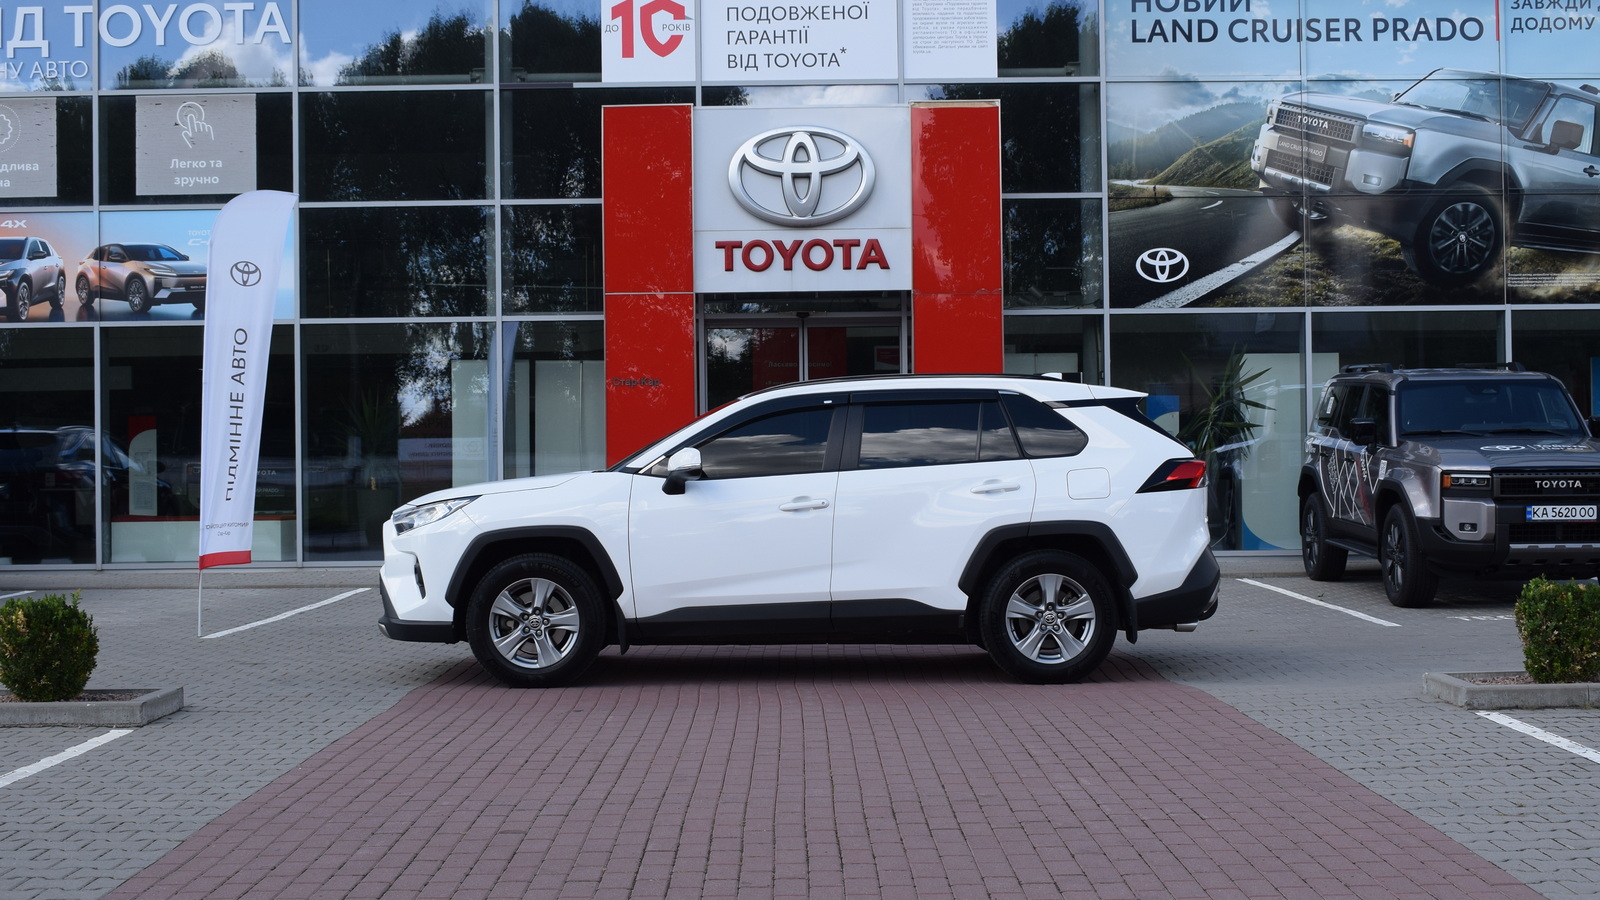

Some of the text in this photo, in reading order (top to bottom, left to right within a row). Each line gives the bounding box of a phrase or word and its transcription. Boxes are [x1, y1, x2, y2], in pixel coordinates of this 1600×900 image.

[727, 1, 870, 24] ПОДОВЖЕНОЇ
[1510, 0, 1592, 12] ЗАВЖДИ
[0, 2, 291, 58] Д TOYOTA
[605, 24, 619, 33] ДО
[662, 23, 691, 31] РОКІВ
[1131, 17, 1484, 43] LAND CRUISER PRADO
[1511, 16, 1596, 33] ДОДОМУ
[727, 26, 810, 45] ГАРАНТІЇ
[30, 60, 88, 78] АВТО
[727, 53, 759, 71] ВІД
[1297, 115, 1329, 129] TOYOTA
[1279, 140, 1290, 148] LAND
[170, 158, 223, 169] Легко та
[174, 175, 220, 187] зручно
[188, 229, 212, 237] TOYOT
[715, 238, 890, 272] TOYOTA
[231, 327, 248, 386] АВТО
[612, 377, 661, 388] Стар-Кар
[1535, 480, 1582, 489] TOYOTA
[1532, 507, 1549, 518] KA
[1551, 507, 1577, 518] 5620
